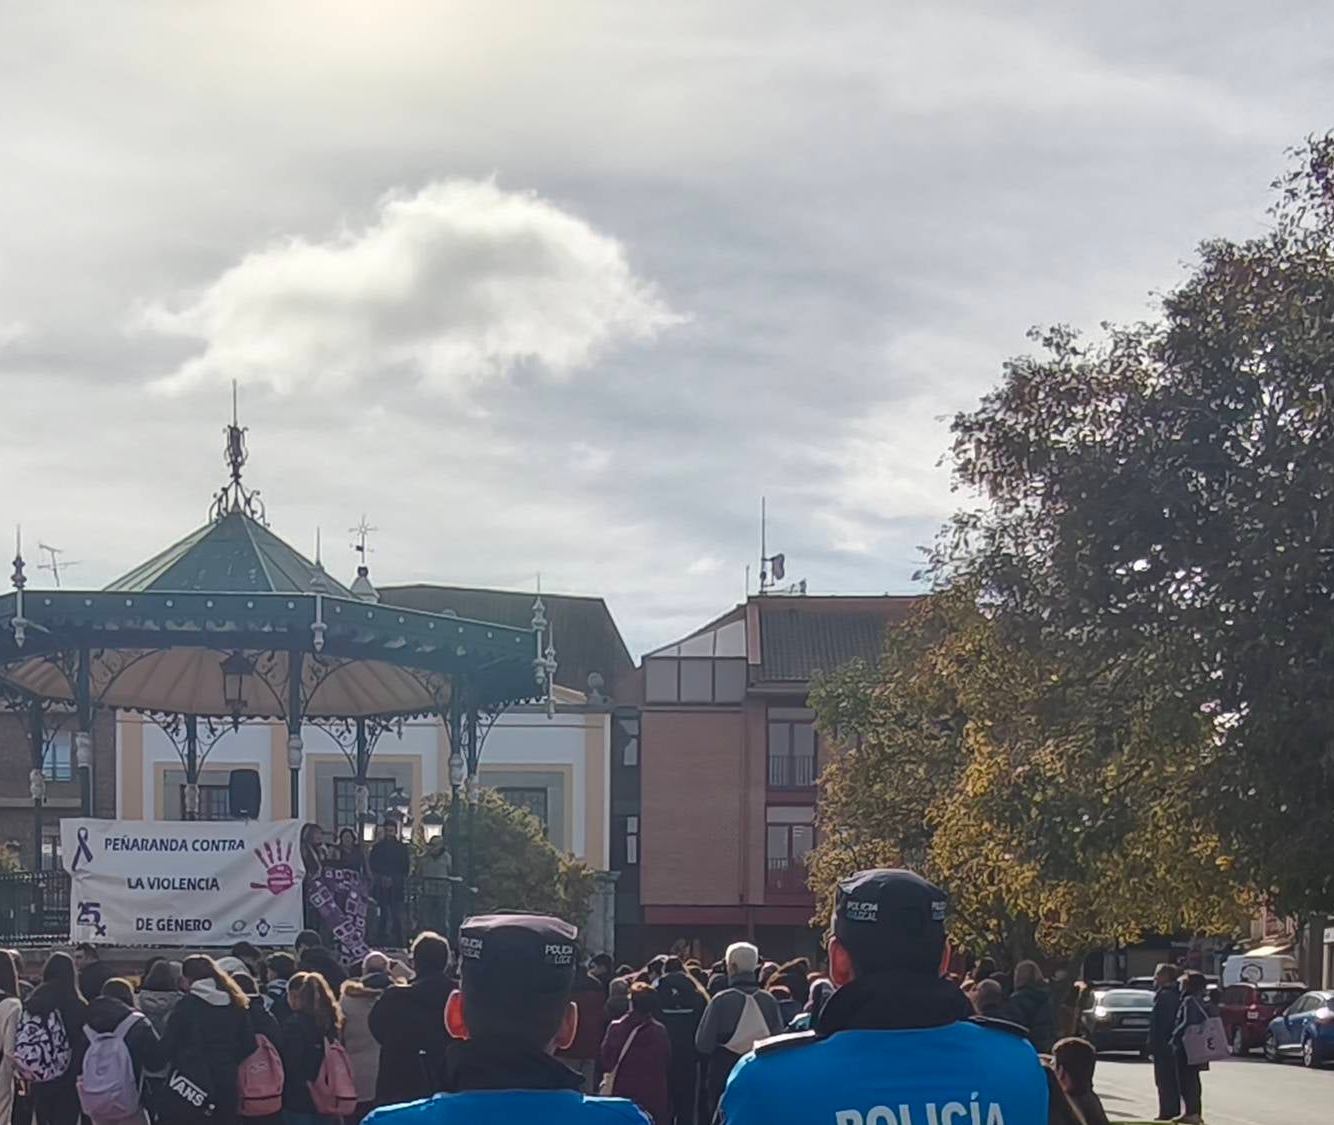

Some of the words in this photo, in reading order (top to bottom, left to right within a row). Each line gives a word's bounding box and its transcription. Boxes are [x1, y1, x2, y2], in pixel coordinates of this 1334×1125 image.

[105, 834, 188, 852] PEÑARANDA
[192, 839, 245, 852] CONTRA
[127, 878, 145, 890] LA
[147, 877, 220, 891] VIOLENCIA
[136, 917, 154, 931] DE
[156, 915, 213, 932] GÉNERO
[169, 1069, 208, 1106] VANS
